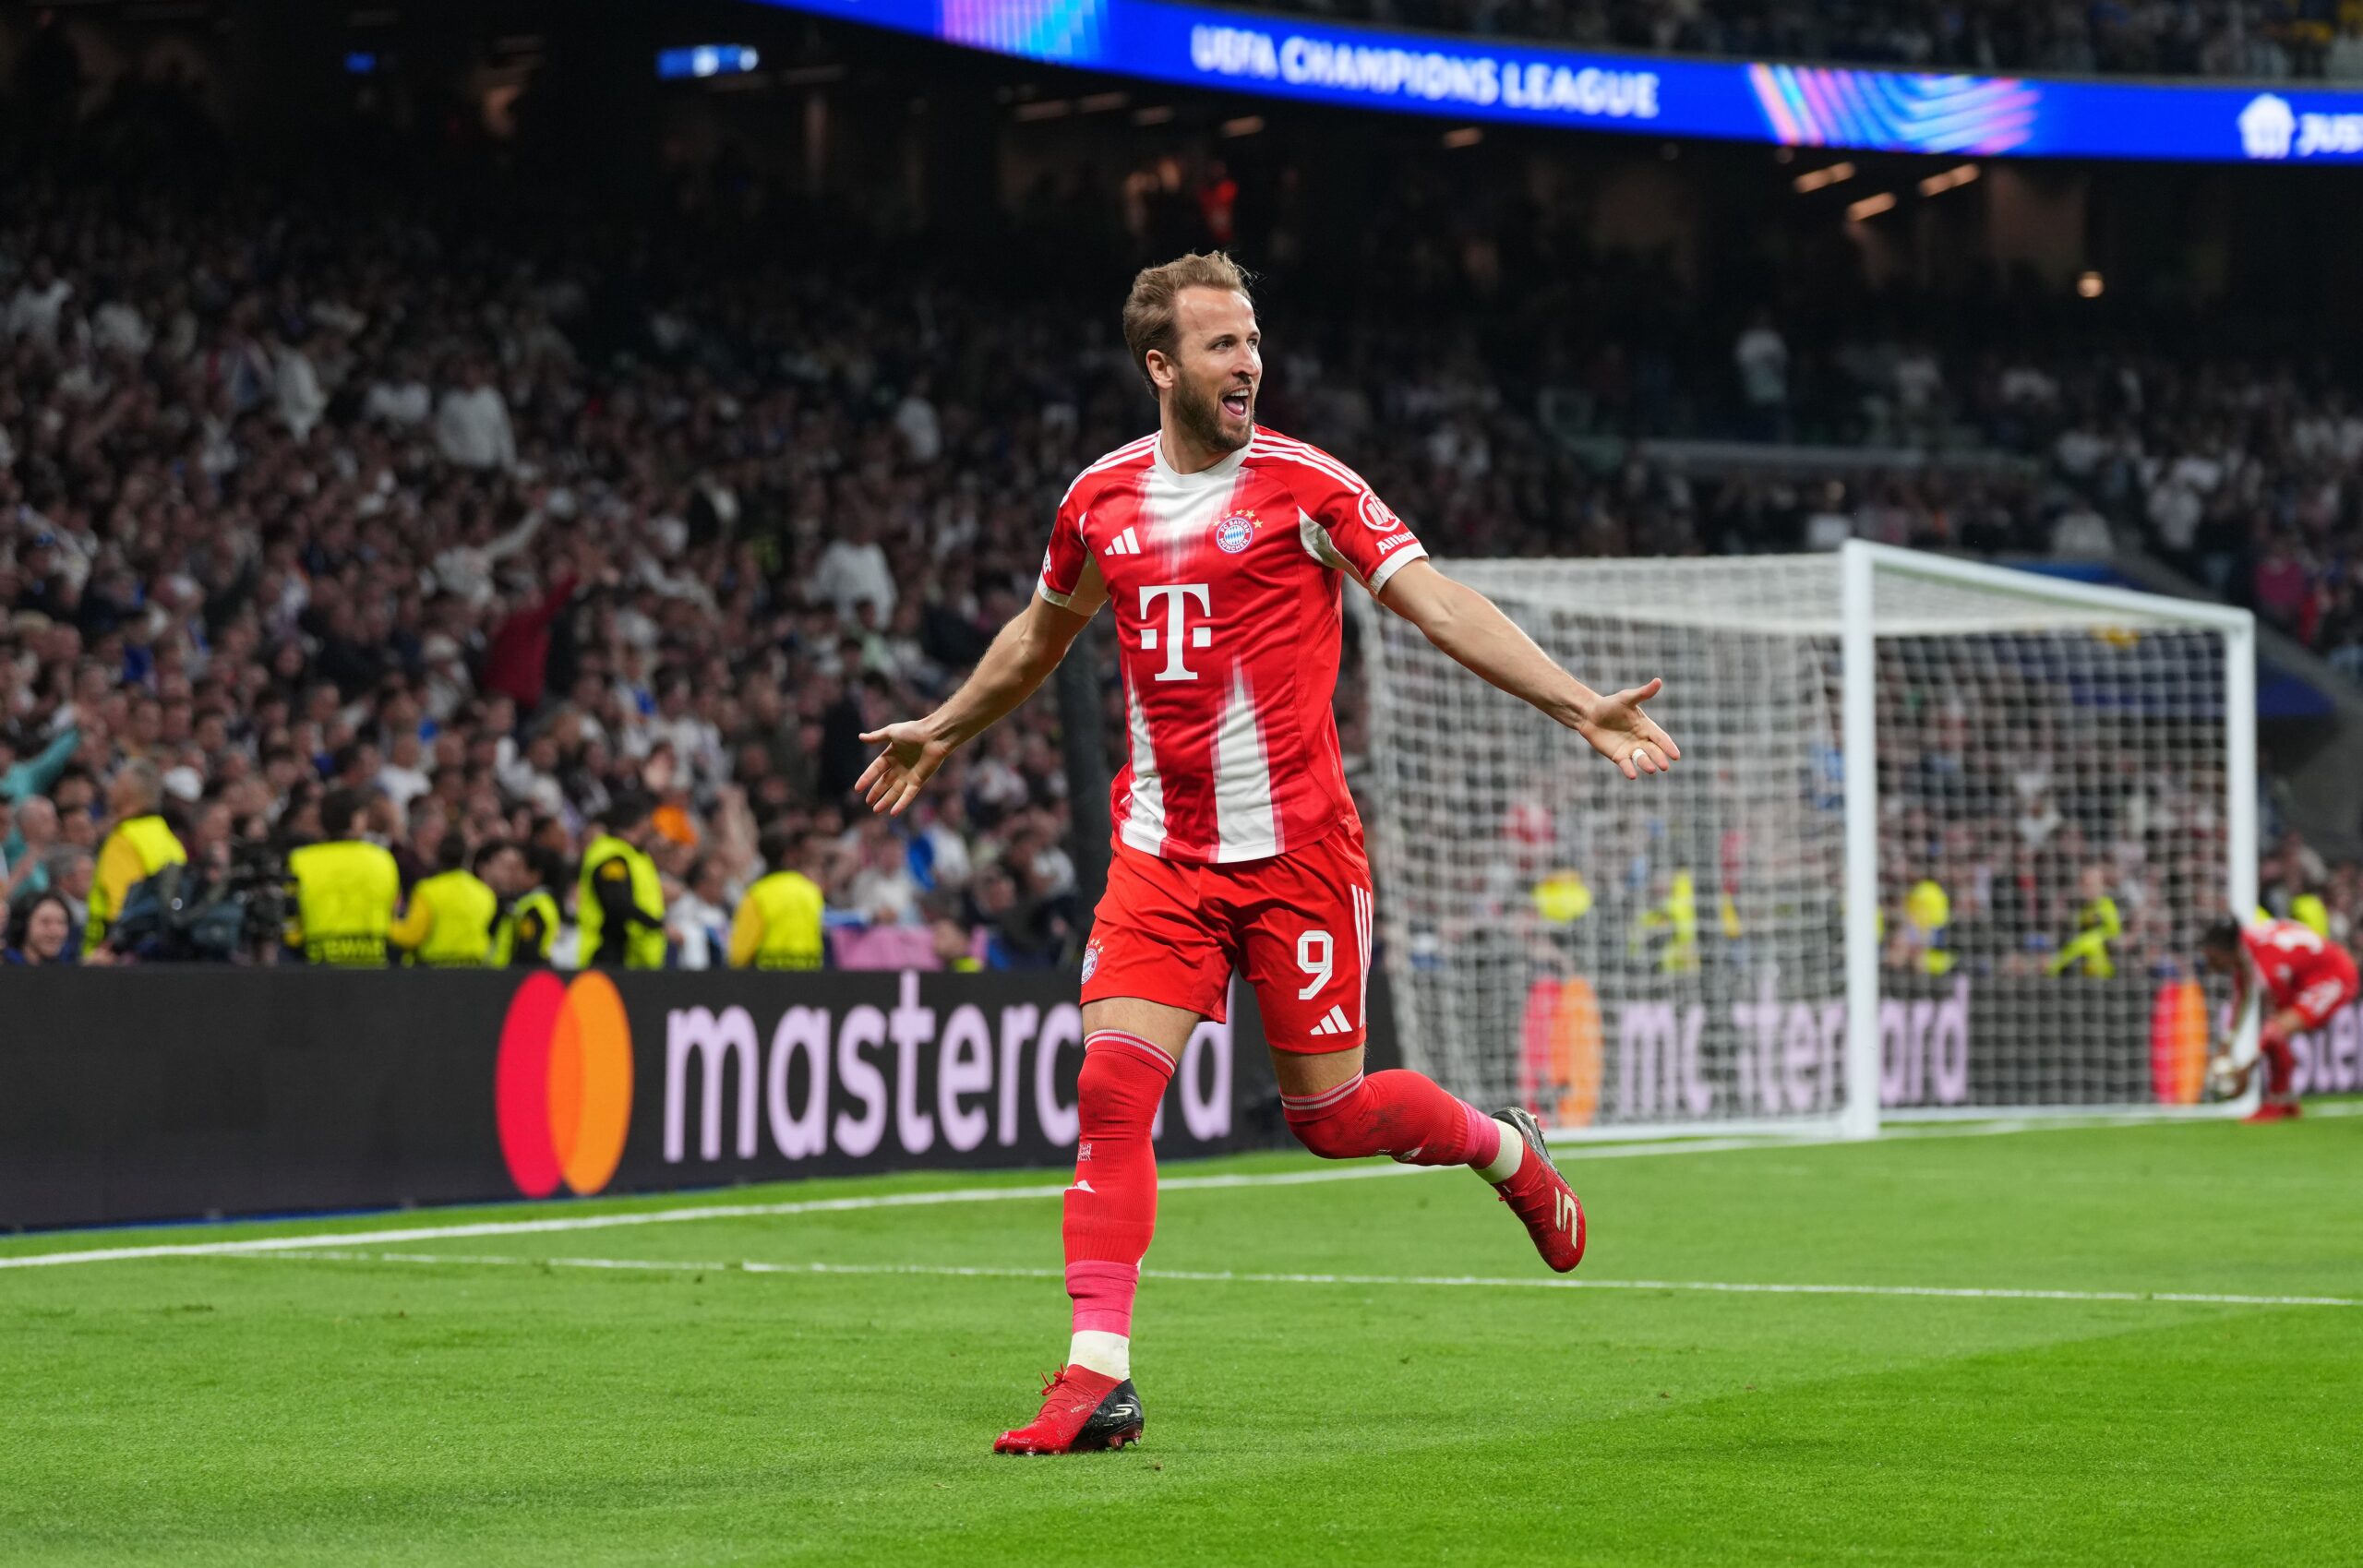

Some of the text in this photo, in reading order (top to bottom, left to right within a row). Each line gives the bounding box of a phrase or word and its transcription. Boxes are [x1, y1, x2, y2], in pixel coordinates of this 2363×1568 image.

[1191, 25, 1660, 118] UEFA CHAMPIONS LEAGUE
[1229, 519, 1251, 533] BAYERN
[1139, 583, 1211, 681] T
[1297, 929, 1334, 999] 9
[663, 967, 1235, 1163] mastercd
